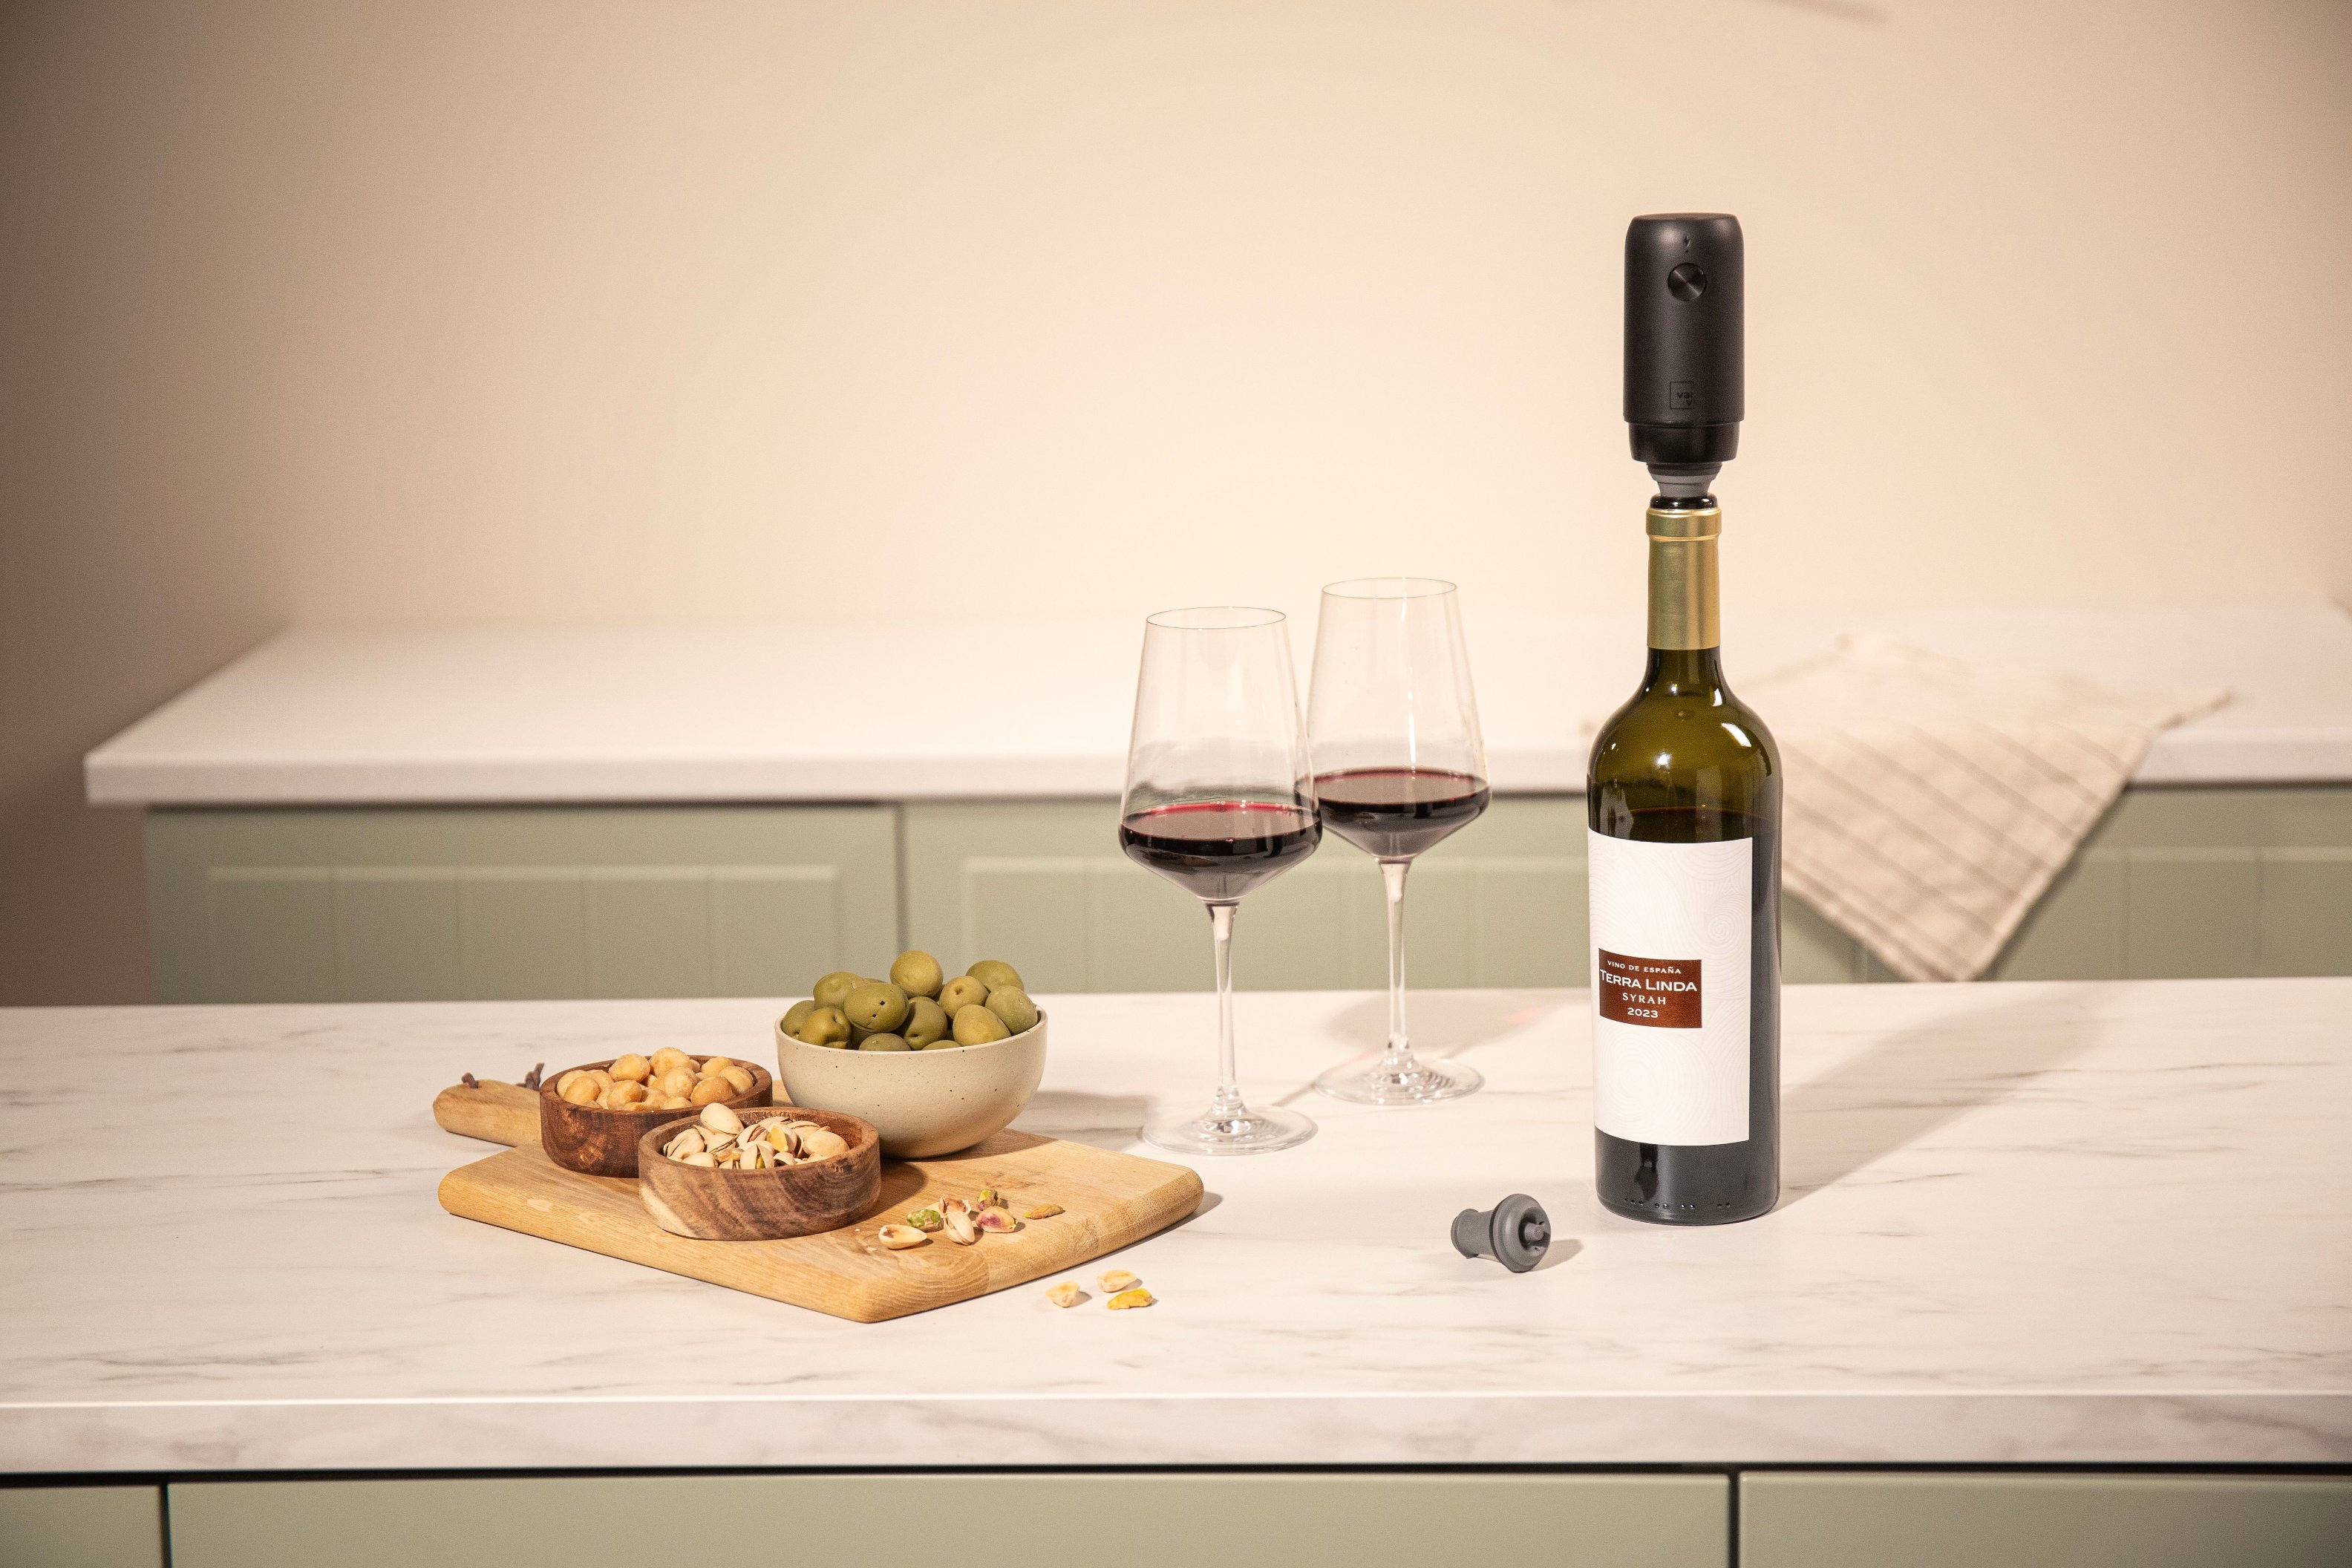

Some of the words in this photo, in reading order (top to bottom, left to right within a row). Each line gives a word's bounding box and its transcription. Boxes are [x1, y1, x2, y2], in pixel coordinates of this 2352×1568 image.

[1607, 960, 1626, 969] VINO
[1600, 969, 1642, 989] TERRA
[1646, 979, 1697, 992] LINDA
[1622, 993, 1666, 1005] SYRAH
[1627, 1007, 1659, 1019] 2023
